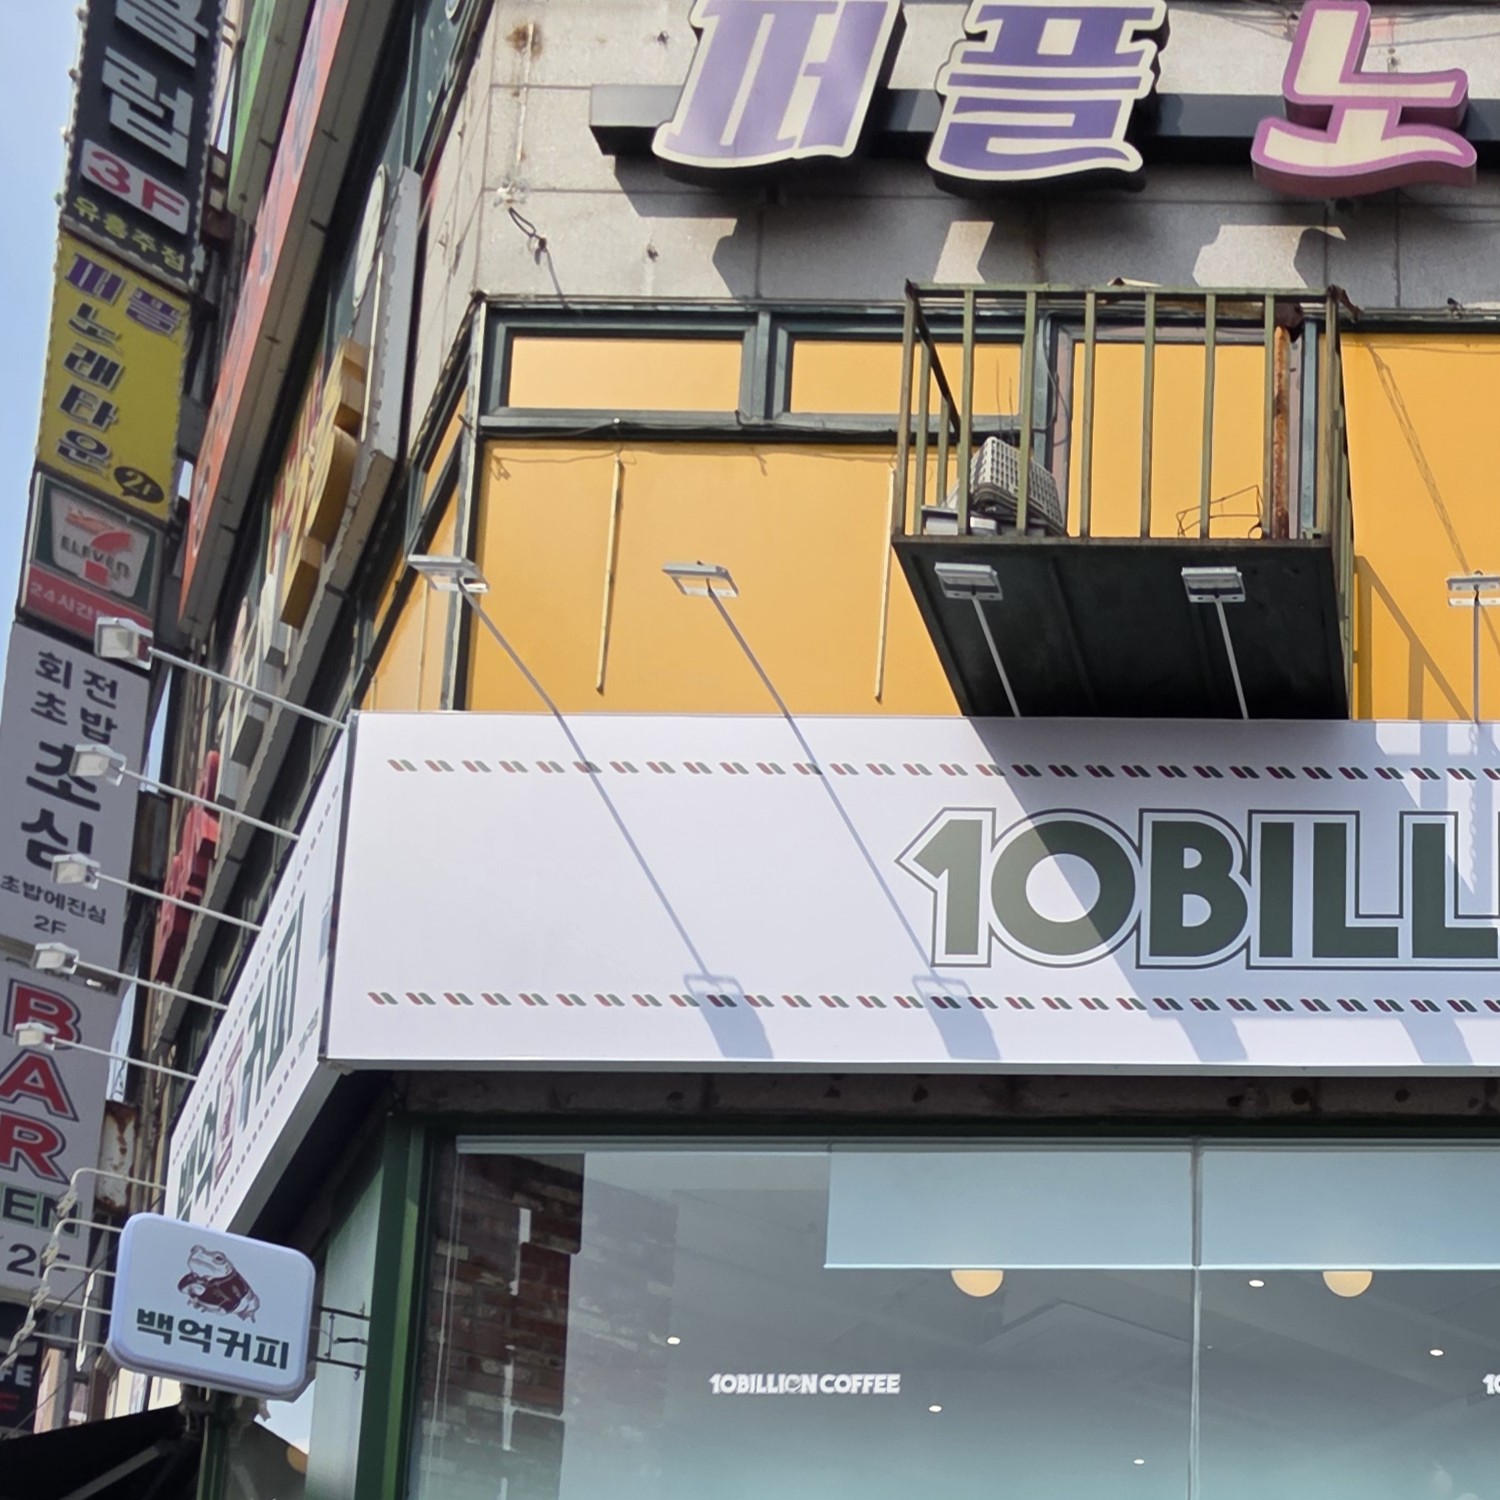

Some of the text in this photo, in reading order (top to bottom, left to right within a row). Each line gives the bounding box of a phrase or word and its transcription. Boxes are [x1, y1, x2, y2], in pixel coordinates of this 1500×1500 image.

[88, 150, 185, 217] 3F
[73, 196, 185, 273] 유흥주점
[56, 302, 127, 478] 노래타운
[35, 651, 118, 709] 회전
[31, 690, 118, 745] 초밥
[0, 875, 107, 925] 초밥에진심
[33, 914, 67, 934] 2F
[0, 978, 82, 1187] BAR
[136, 1308, 290, 1370] 백억커피
[709, 1373, 901, 1395] 10BILLION COFFEE
